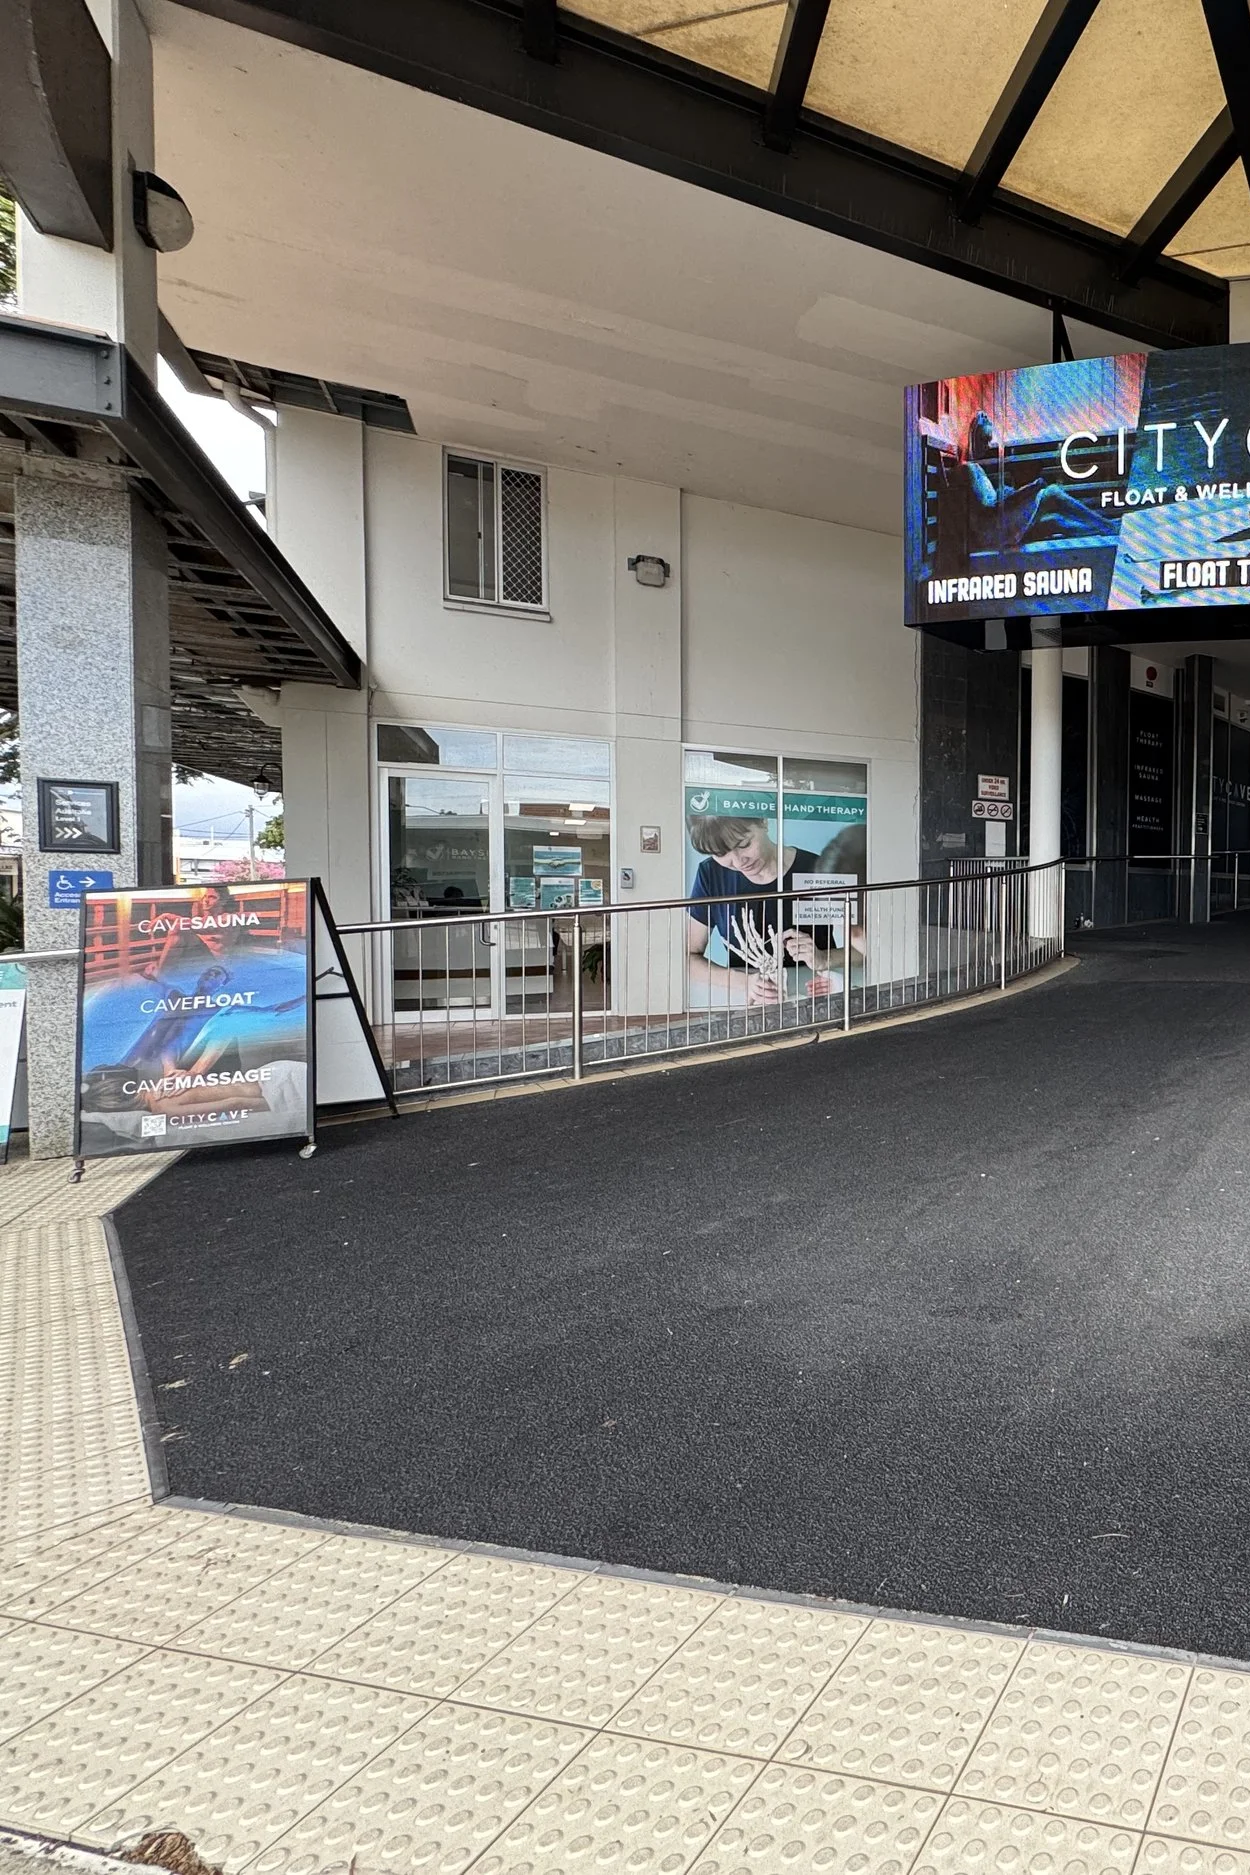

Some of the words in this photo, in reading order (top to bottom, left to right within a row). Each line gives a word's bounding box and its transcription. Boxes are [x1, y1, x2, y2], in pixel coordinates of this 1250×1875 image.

[1101, 487, 1168, 508] FLOAT
[1174, 486, 1189, 503] &
[927, 573, 1017, 603] INFRARED
[1023, 567, 1093, 597] SAUNA
[1163, 559, 1232, 589] FLOAT
[1136, 737, 1163, 748] THERAPY
[1140, 730, 1159, 739] FLOAT
[1139, 772, 1159, 781] SAUNA
[723, 800, 776, 811] BAYSIDE
[784, 804, 815, 813] HAND
[817, 805, 864, 815] THERAPY
[451, 848, 488, 857] BAYSI
[138, 912, 260, 934] CAVESAUNA
[140, 992, 255, 1014] CAVEFLOAT
[122, 1068, 272, 1095] CAVEMASSAGE
